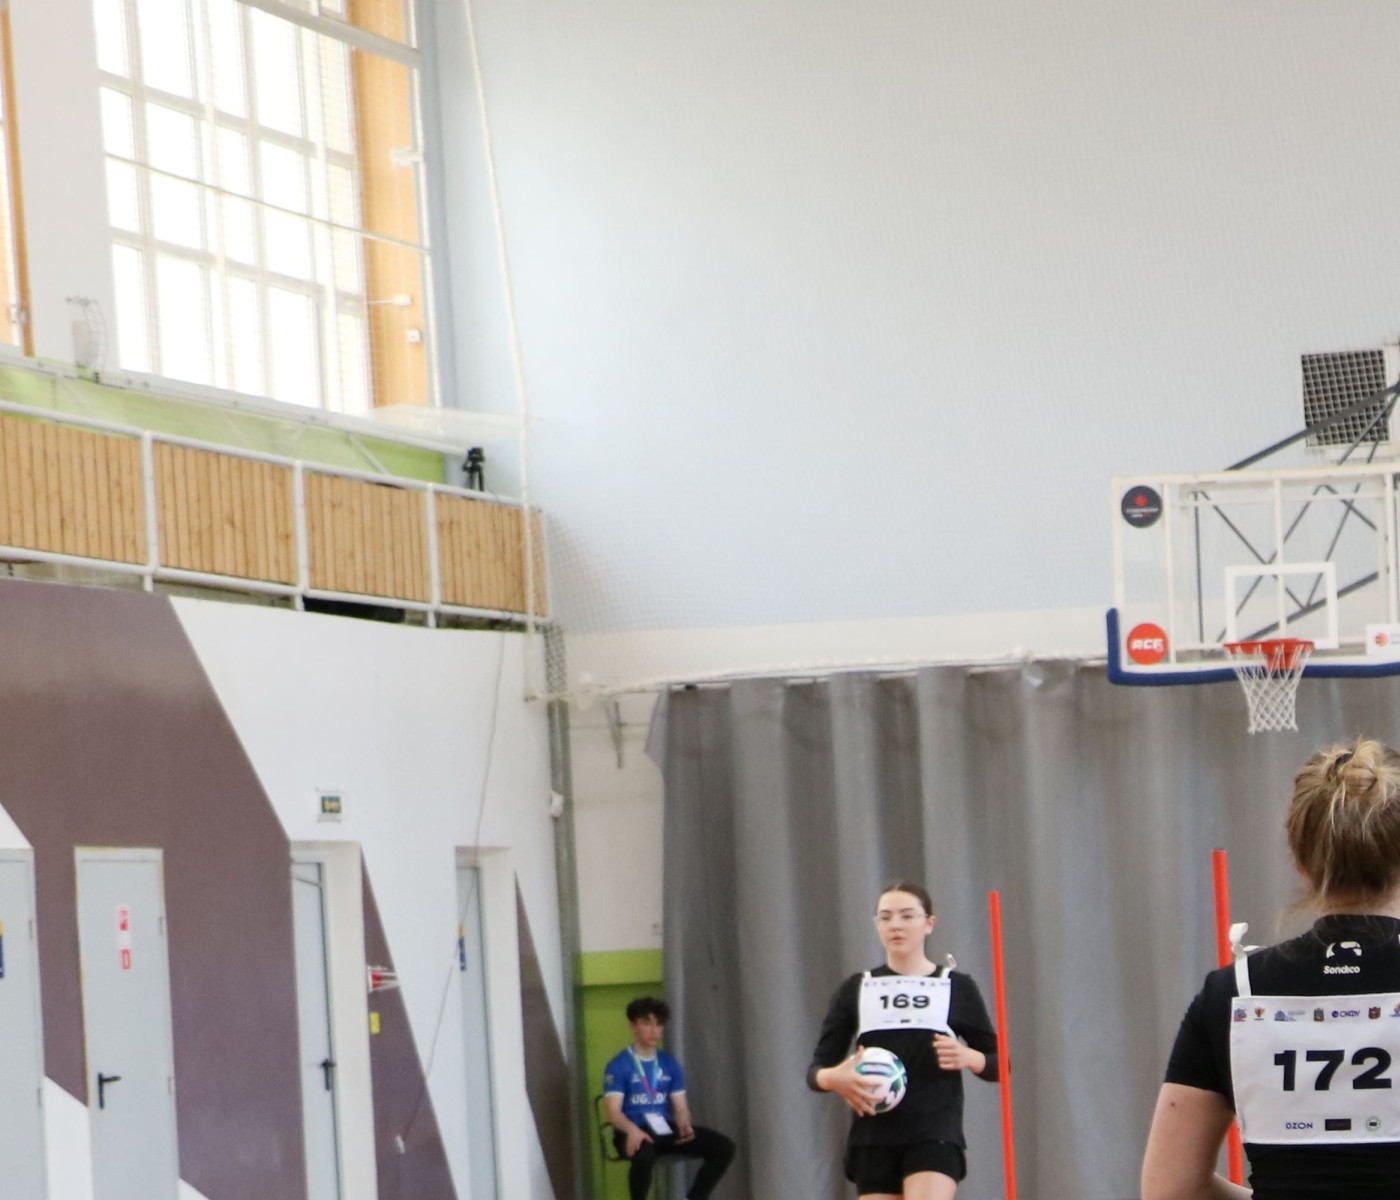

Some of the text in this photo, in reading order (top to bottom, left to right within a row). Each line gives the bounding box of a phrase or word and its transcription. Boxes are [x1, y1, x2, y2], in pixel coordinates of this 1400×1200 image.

[1323, 965, 1361, 975] Sondico
[880, 993, 930, 1009] 169
[1274, 1046, 1392, 1091] 172
[1285, 1122, 1314, 1130] OZON
